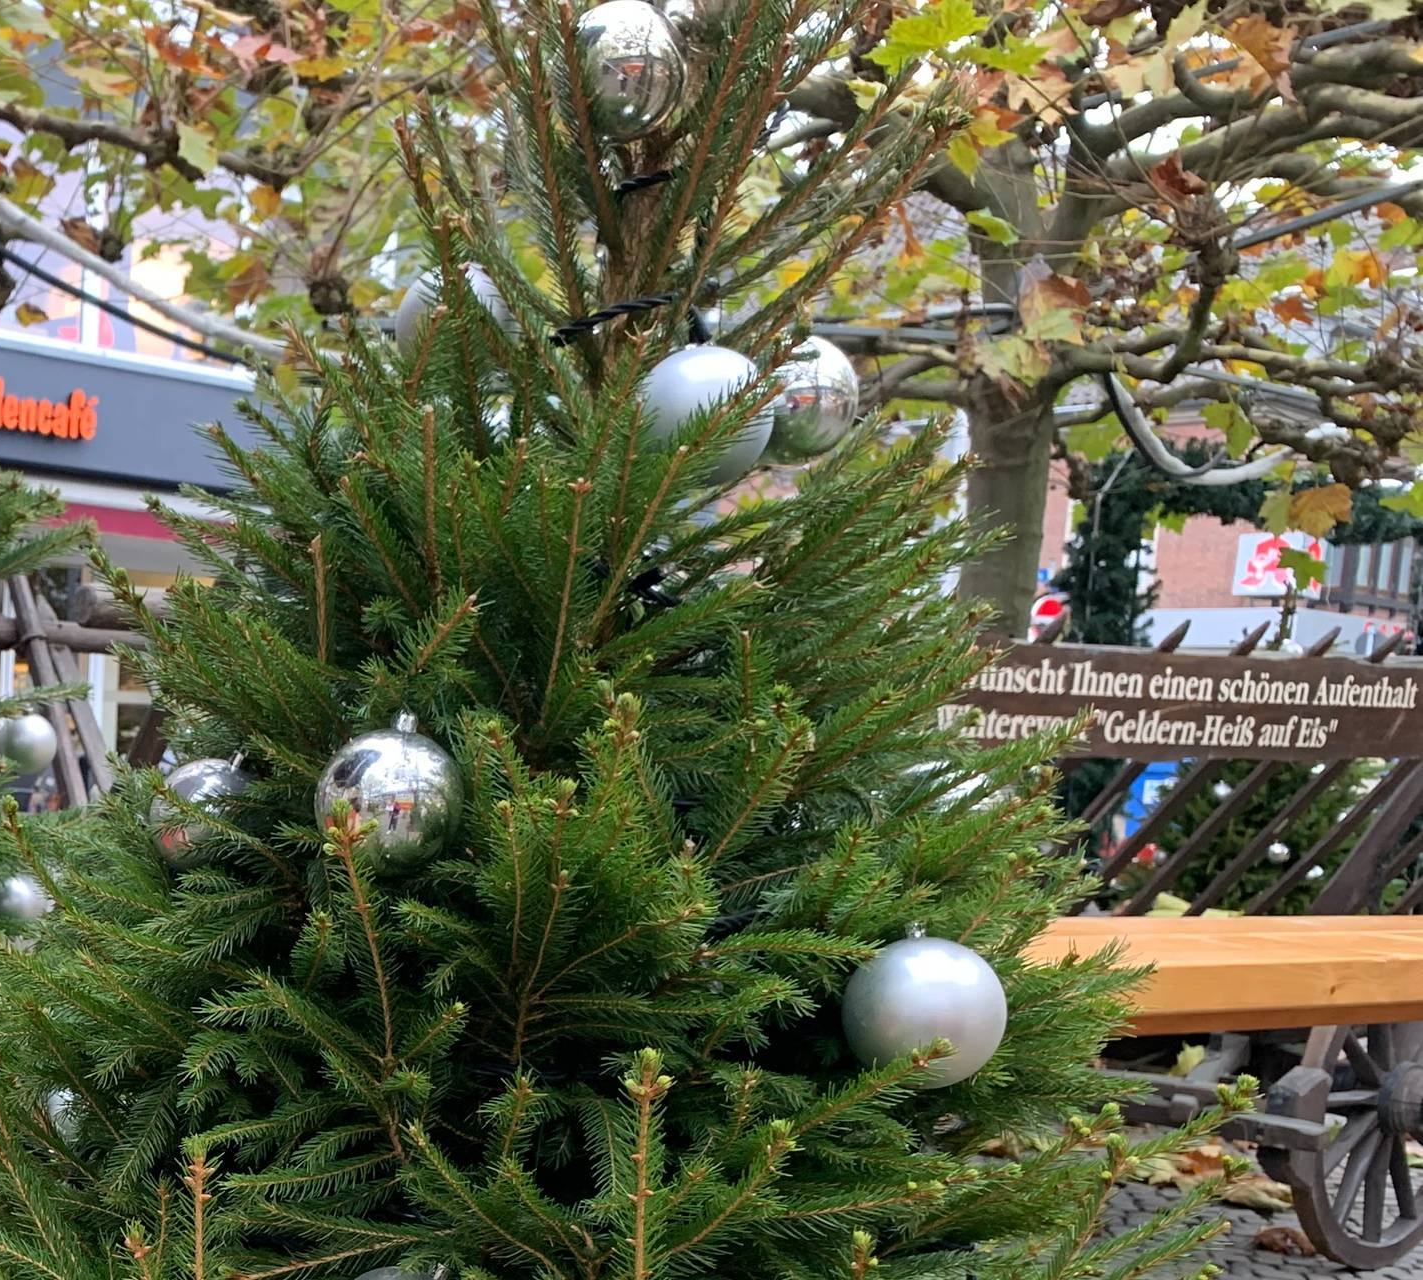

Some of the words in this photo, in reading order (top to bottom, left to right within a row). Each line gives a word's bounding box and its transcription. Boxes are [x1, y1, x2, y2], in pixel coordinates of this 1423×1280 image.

[1070, 659, 1144, 699] Ihnen
[1149, 666, 1213, 701] einen
[1216, 669, 1310, 705] schönen
[1312, 674, 1419, 709] Aufenthalt
[1257, 715, 1299, 748] auf
[1294, 717, 1339, 748] Eis"
